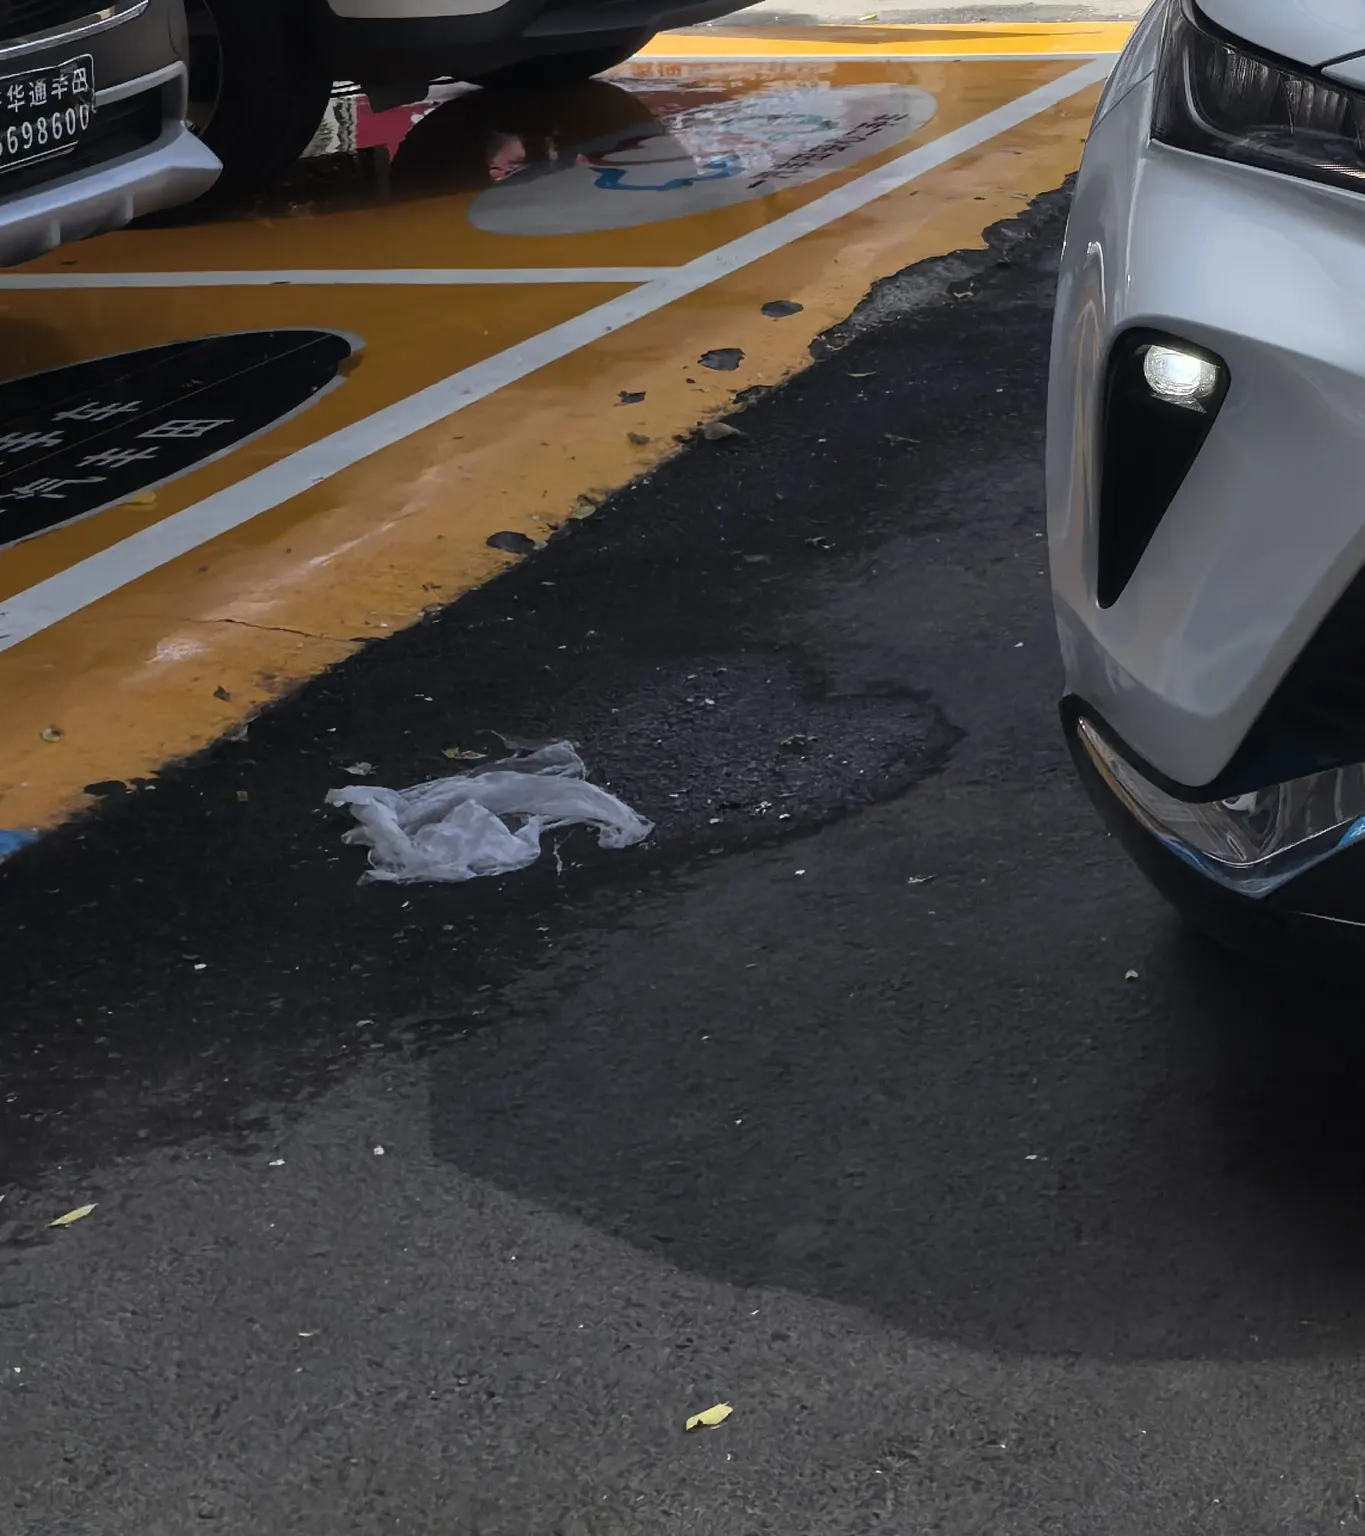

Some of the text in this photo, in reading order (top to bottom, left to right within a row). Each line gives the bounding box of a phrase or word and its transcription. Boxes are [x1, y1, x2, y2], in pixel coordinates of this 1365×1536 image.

[0, 68, 89, 113] 华通丰田
[0, 401, 143, 453] 手车
[0, 419, 236, 512] 汽丰田
